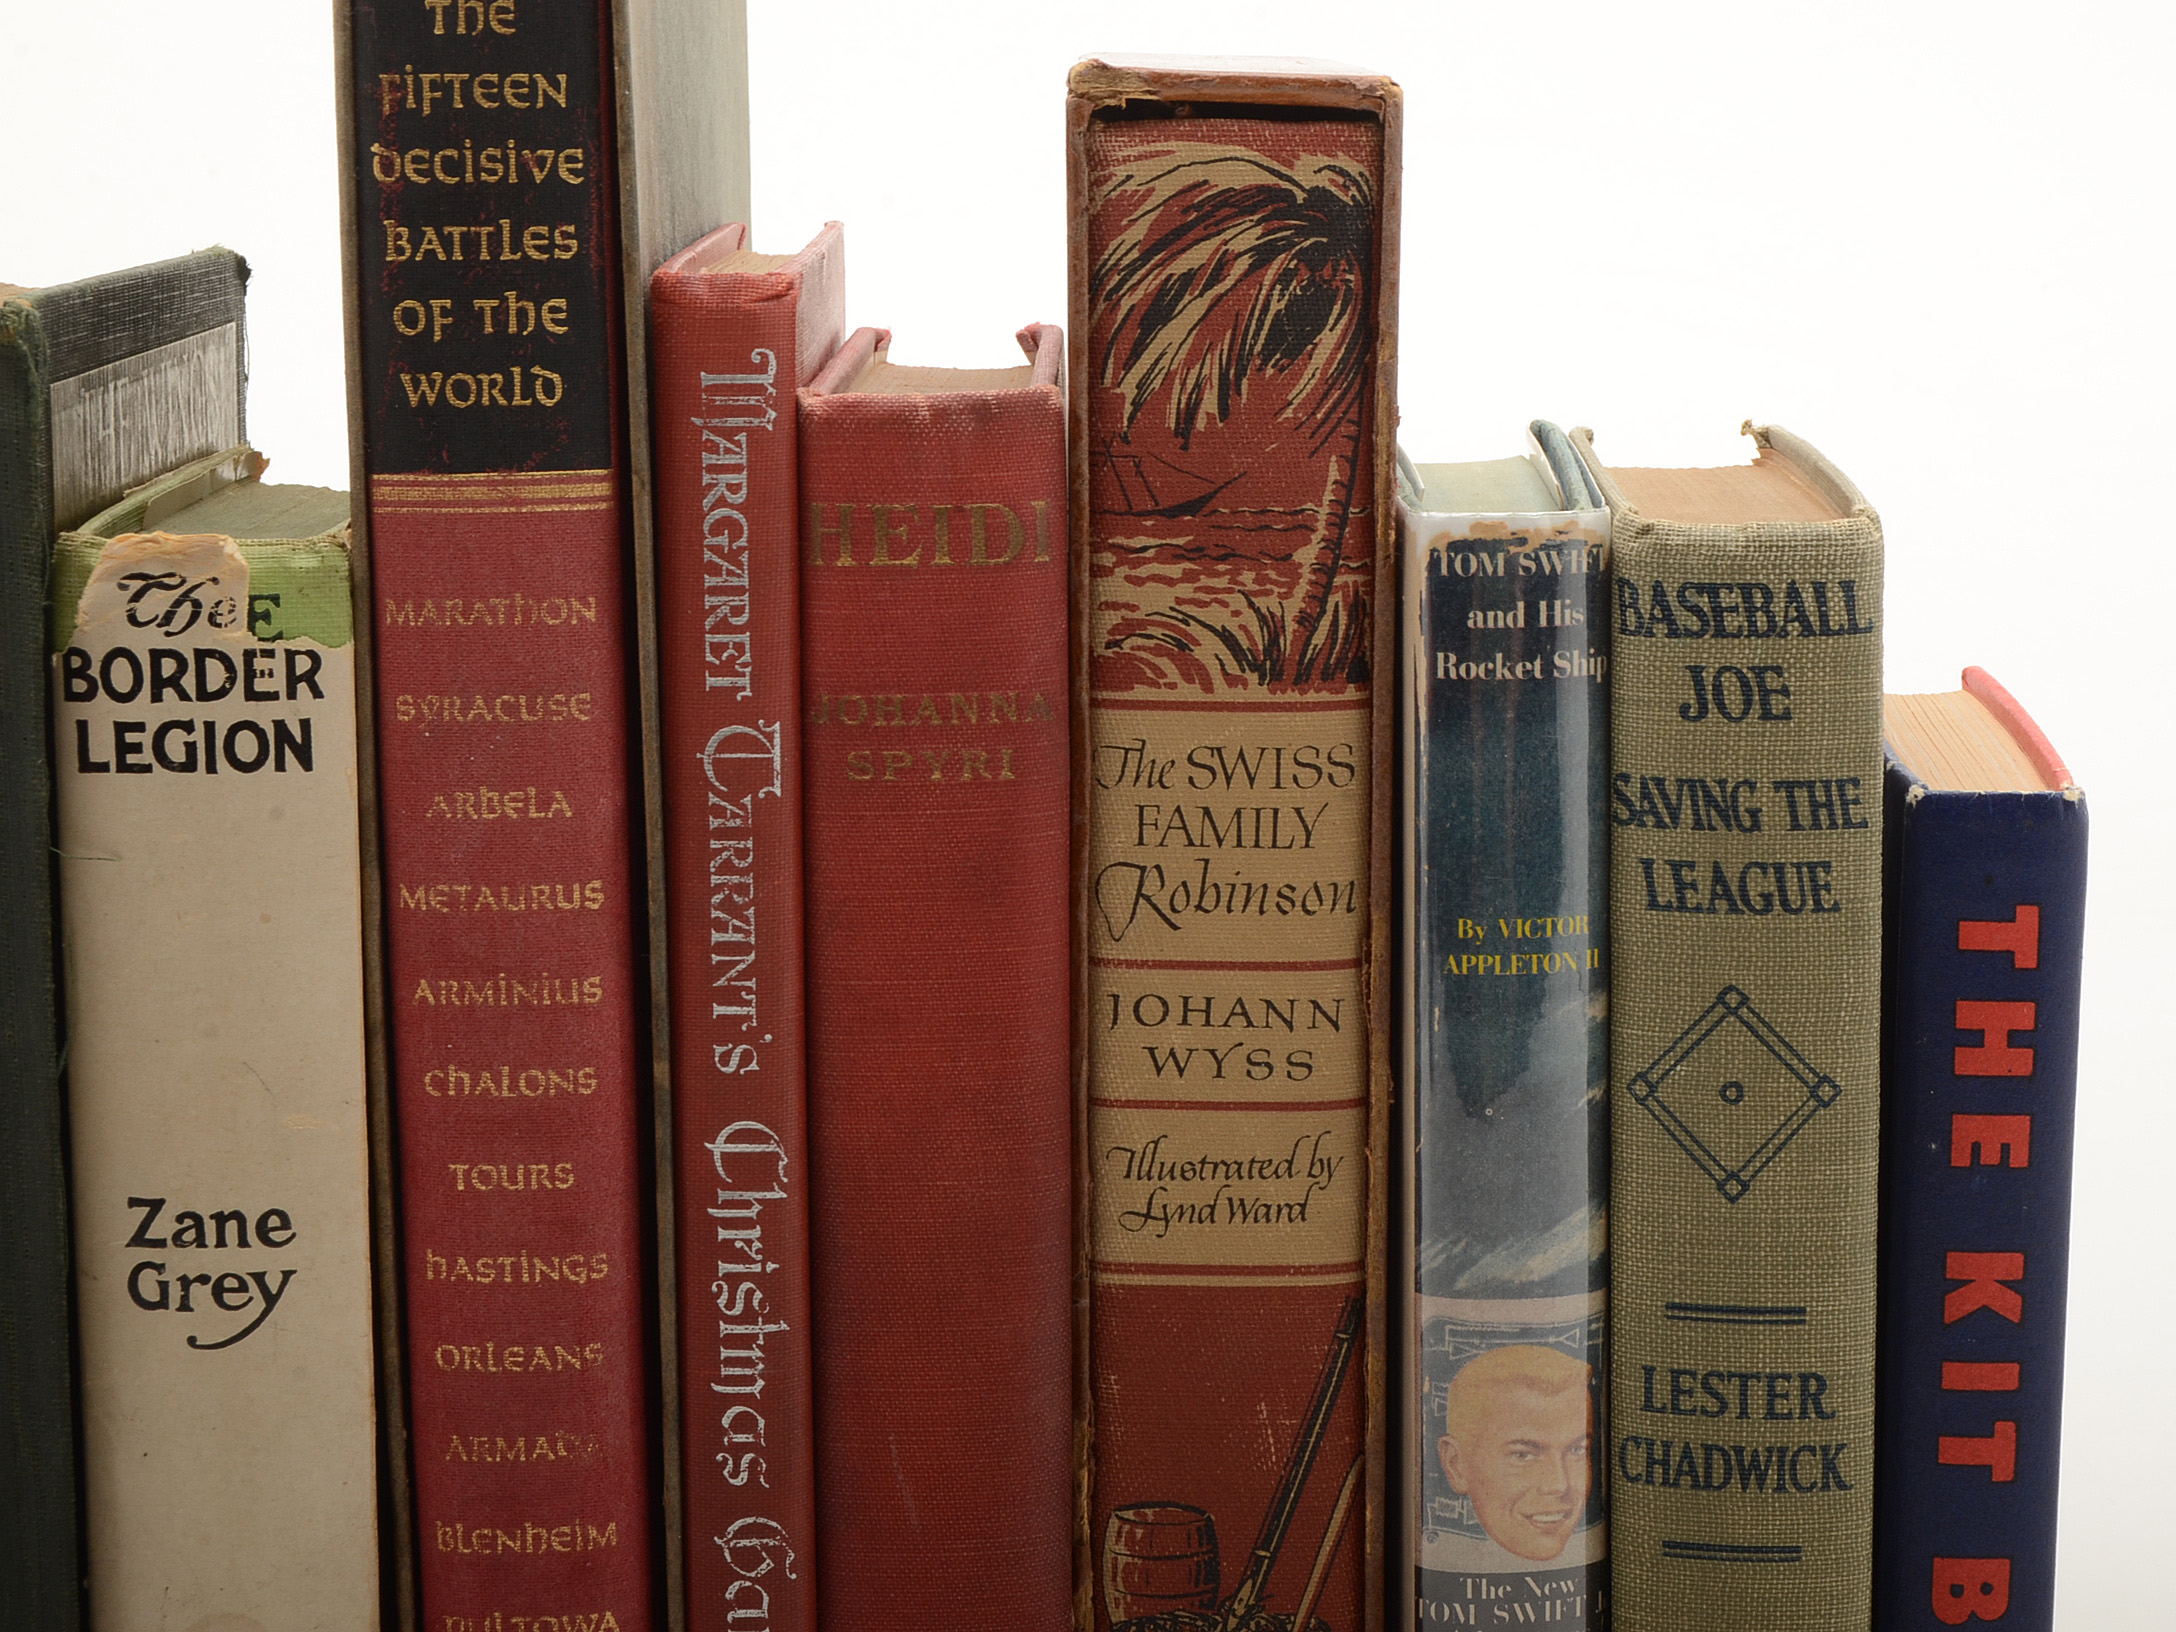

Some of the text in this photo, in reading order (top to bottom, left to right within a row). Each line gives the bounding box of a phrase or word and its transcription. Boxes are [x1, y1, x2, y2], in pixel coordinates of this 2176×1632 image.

[425, 0, 517, 35] THE
[378, 64, 567, 116] FIFTEEN
[371, 140, 585, 184] DECISIVE
[384, 219, 578, 261] BATTLES
[393, 291, 569, 342] OF THE
[400, 365, 563, 409] WORLD
[807, 500, 1050, 569] HEIDI
[1433, 550, 1505, 577] TOM
[116, 571, 237, 637] The
[386, 593, 596, 626] MARATHON
[1467, 599, 1585, 629] and His
[1617, 578, 1874, 640] BASEBALL
[61, 646, 325, 704] BORDER
[1436, 648, 1607, 683] Rocket Ship
[396, 692, 592, 728] SYRACUSE
[811, 692, 1054, 726] JOHANNA
[1679, 665, 1793, 723] JOE
[75, 717, 314, 775] LEGION
[847, 749, 1016, 781] SPYRI
[1094, 738, 1356, 791] The SWISS
[426, 786, 573, 819] ARBELA
[1612, 772, 1868, 833] SAVING THE
[1133, 802, 1329, 850] FAMILY
[400, 880, 605, 912] METAURUS
[1095, 858, 1358, 942] Robinson
[1639, 857, 1840, 915] LEAGUE
[1458, 914, 1589, 945] By VICTOR
[1443, 948, 1599, 975] APPLETON II
[413, 972, 604, 1006] ARMINIUS
[1108, 994, 1345, 1033] JOHANN
[1950, 904, 2041, 1168] THE
[424, 1064, 598, 1097] CHALONS
[1142, 1042, 1315, 1082] WYSS
[448, 1163, 575, 1190] TOURS
[1105, 1130, 1344, 1190] Illustrated by
[125, 1196, 297, 1249] Zane
[1118, 1183, 1321, 1238] Lynd Ward
[426, 1249, 609, 1284] HASTINGS
[127, 1261, 297, 1350] Grey
[703, 1119, 791, 1490] Christmas
[434, 1341, 604, 1373] ORLEANS
[1938, 1251, 2026, 1483] KIT
[1640, 1364, 1837, 1421] LESTER
[1618, 1435, 1853, 1494] CHADWICK
[436, 1518, 618, 1554] BLENHEIM
[713, 1516, 797, 1632] Ga
[1459, 1576, 1578, 1599] The New
[1416, 1598, 1476, 1625] TOM
[1493, 1594, 1587, 1624] SWIFT
